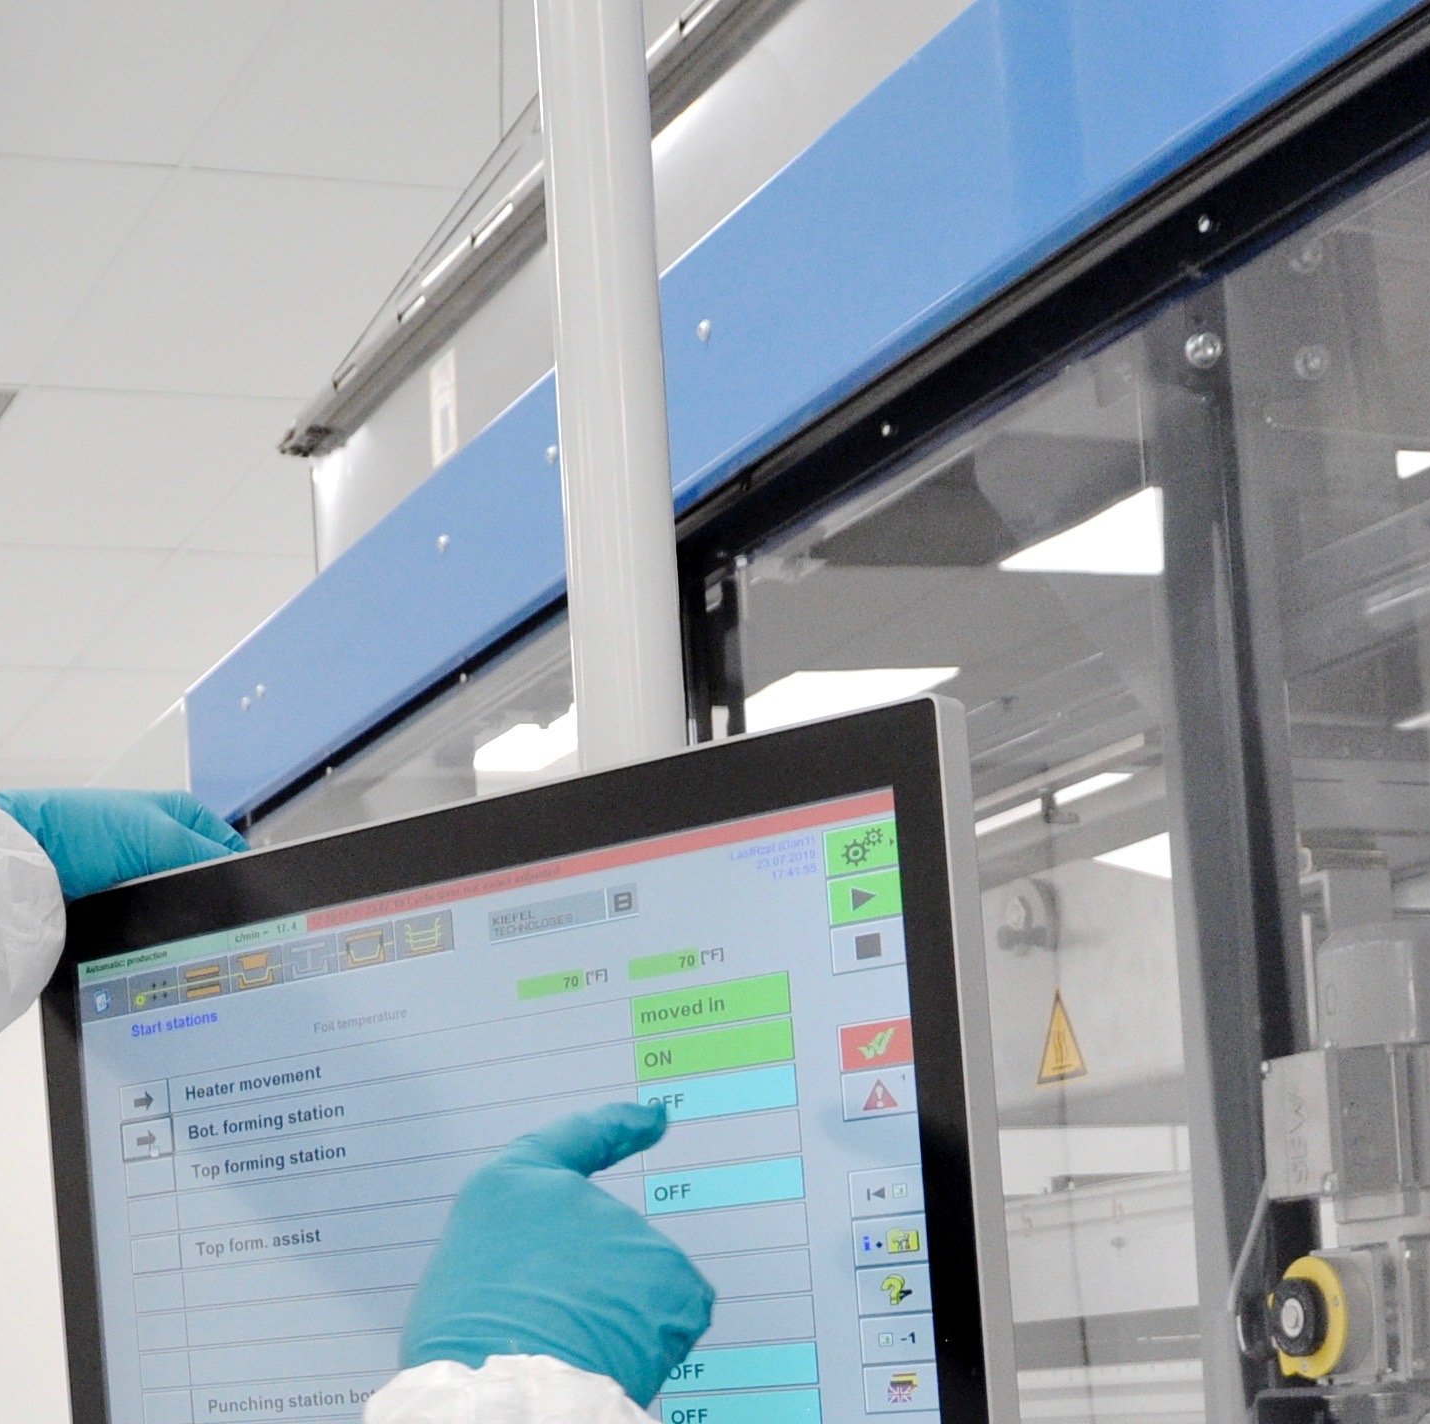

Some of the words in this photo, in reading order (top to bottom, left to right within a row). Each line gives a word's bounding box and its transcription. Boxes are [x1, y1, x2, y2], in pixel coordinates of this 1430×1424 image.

[492, 909, 535, 926] KIEFEL
[126, 950, 169, 967] production
[679, 954, 696, 969] 70
[563, 976, 580, 989] 70
[313, 1018, 335, 1034] Foil
[336, 1007, 408, 1032] temperature
[640, 999, 704, 1025] moved
[708, 996, 726, 1013] in
[131, 1021, 162, 1037] Start
[165, 1010, 219, 1032] stations
[643, 1049, 673, 1069] ON
[185, 1081, 235, 1101] Heater
[239, 1065, 323, 1091] movement
[188, 1122, 219, 1140] Bot.
[223, 1112, 284, 1135] forming
[288, 1103, 346, 1124] station
[191, 1162, 221, 1180] Top
[224, 1152, 285, 1175] forming
[289, 1144, 347, 1165] station
[653, 1182, 692, 1202] OFF
[196, 1241, 225, 1258] Top
[229, 1237, 268, 1253] form.
[272, 1228, 322, 1248] assist
[668, 1363, 705, 1381] OFF
[208, 1395, 285, 1414] Punching
[288, 1390, 345, 1409] station
